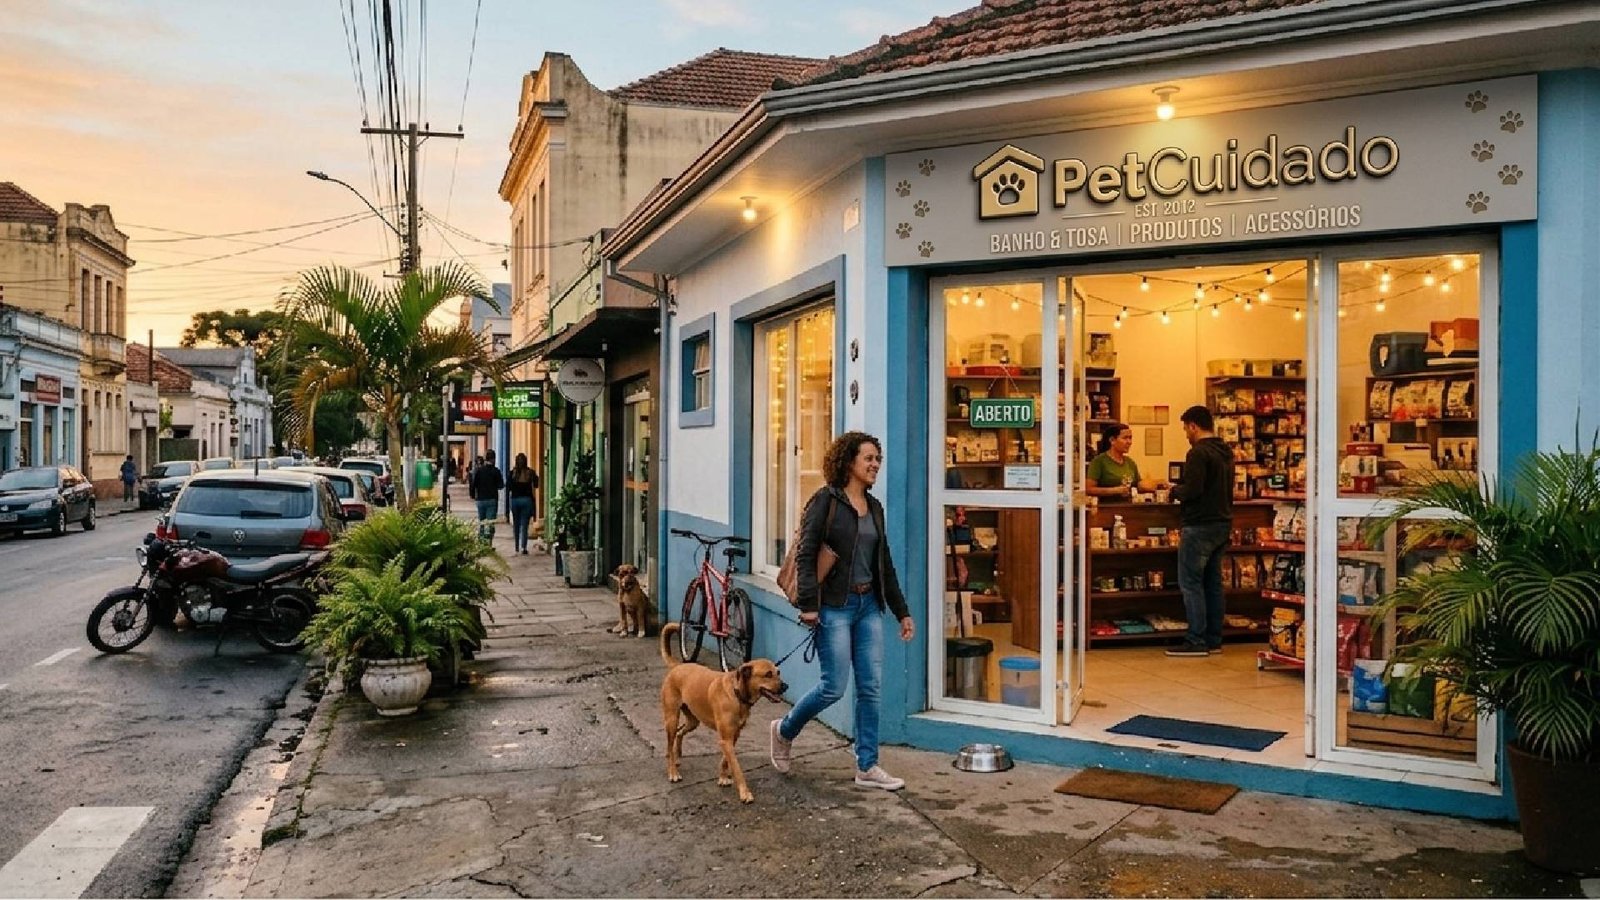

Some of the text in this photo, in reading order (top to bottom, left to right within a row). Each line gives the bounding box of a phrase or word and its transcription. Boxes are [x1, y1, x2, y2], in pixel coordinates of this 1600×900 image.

[1053, 126, 1400, 208] PetCuidado
[1163, 199, 1196, 216] 2012
[990, 204, 1361, 253] BANHO & TOSA PRODUTOS ACESSÓRIOS
[974, 405, 1031, 422] ABERTO
